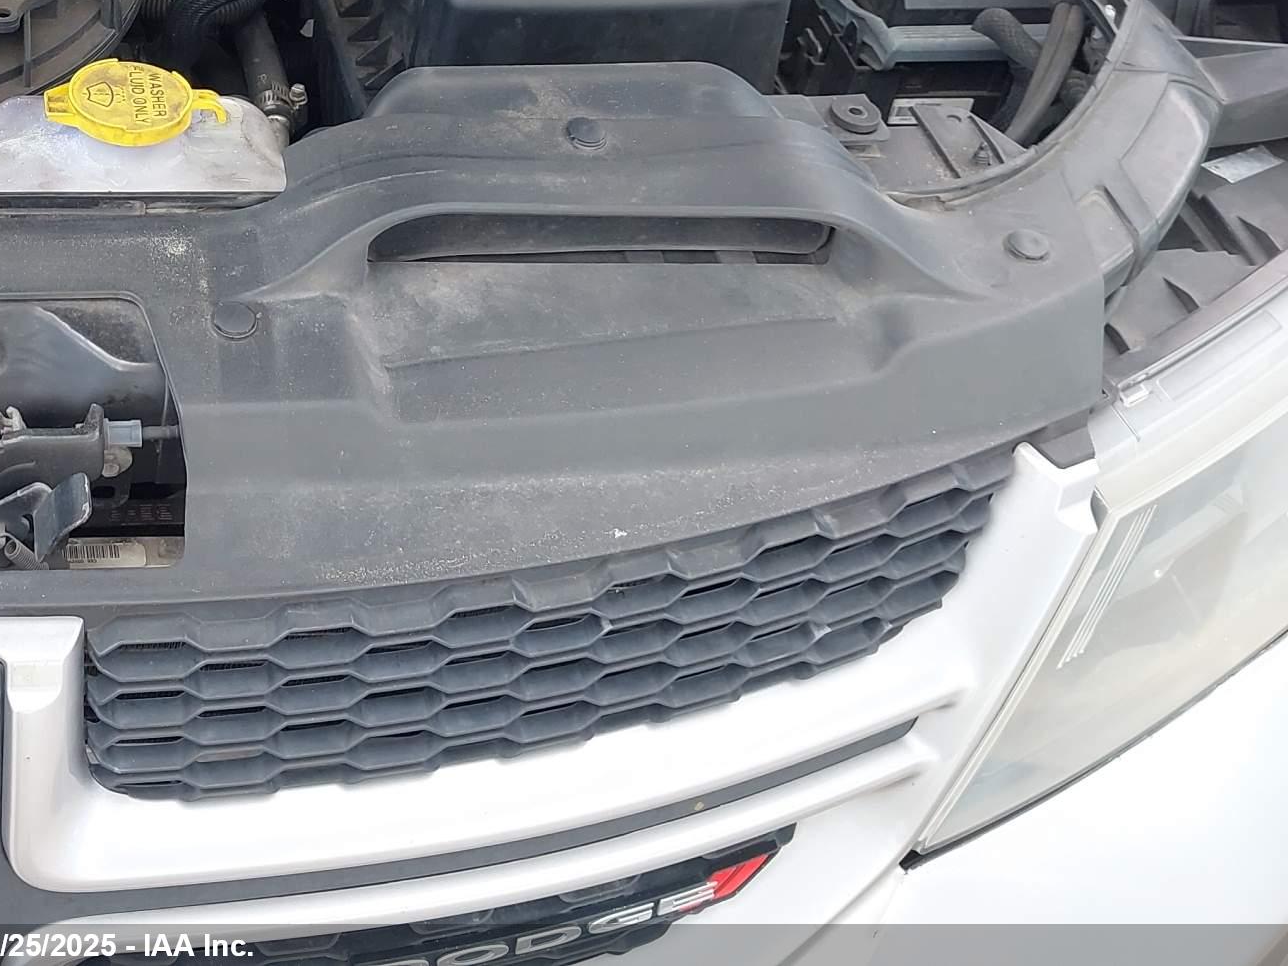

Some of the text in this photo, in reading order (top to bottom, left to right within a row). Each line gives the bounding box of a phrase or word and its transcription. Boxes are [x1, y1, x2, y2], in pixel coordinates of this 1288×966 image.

[128, 65, 150, 123] FLUID ONLY
[148, 72, 168, 117] WASHER
[368, 880, 720, 966] ODGE
